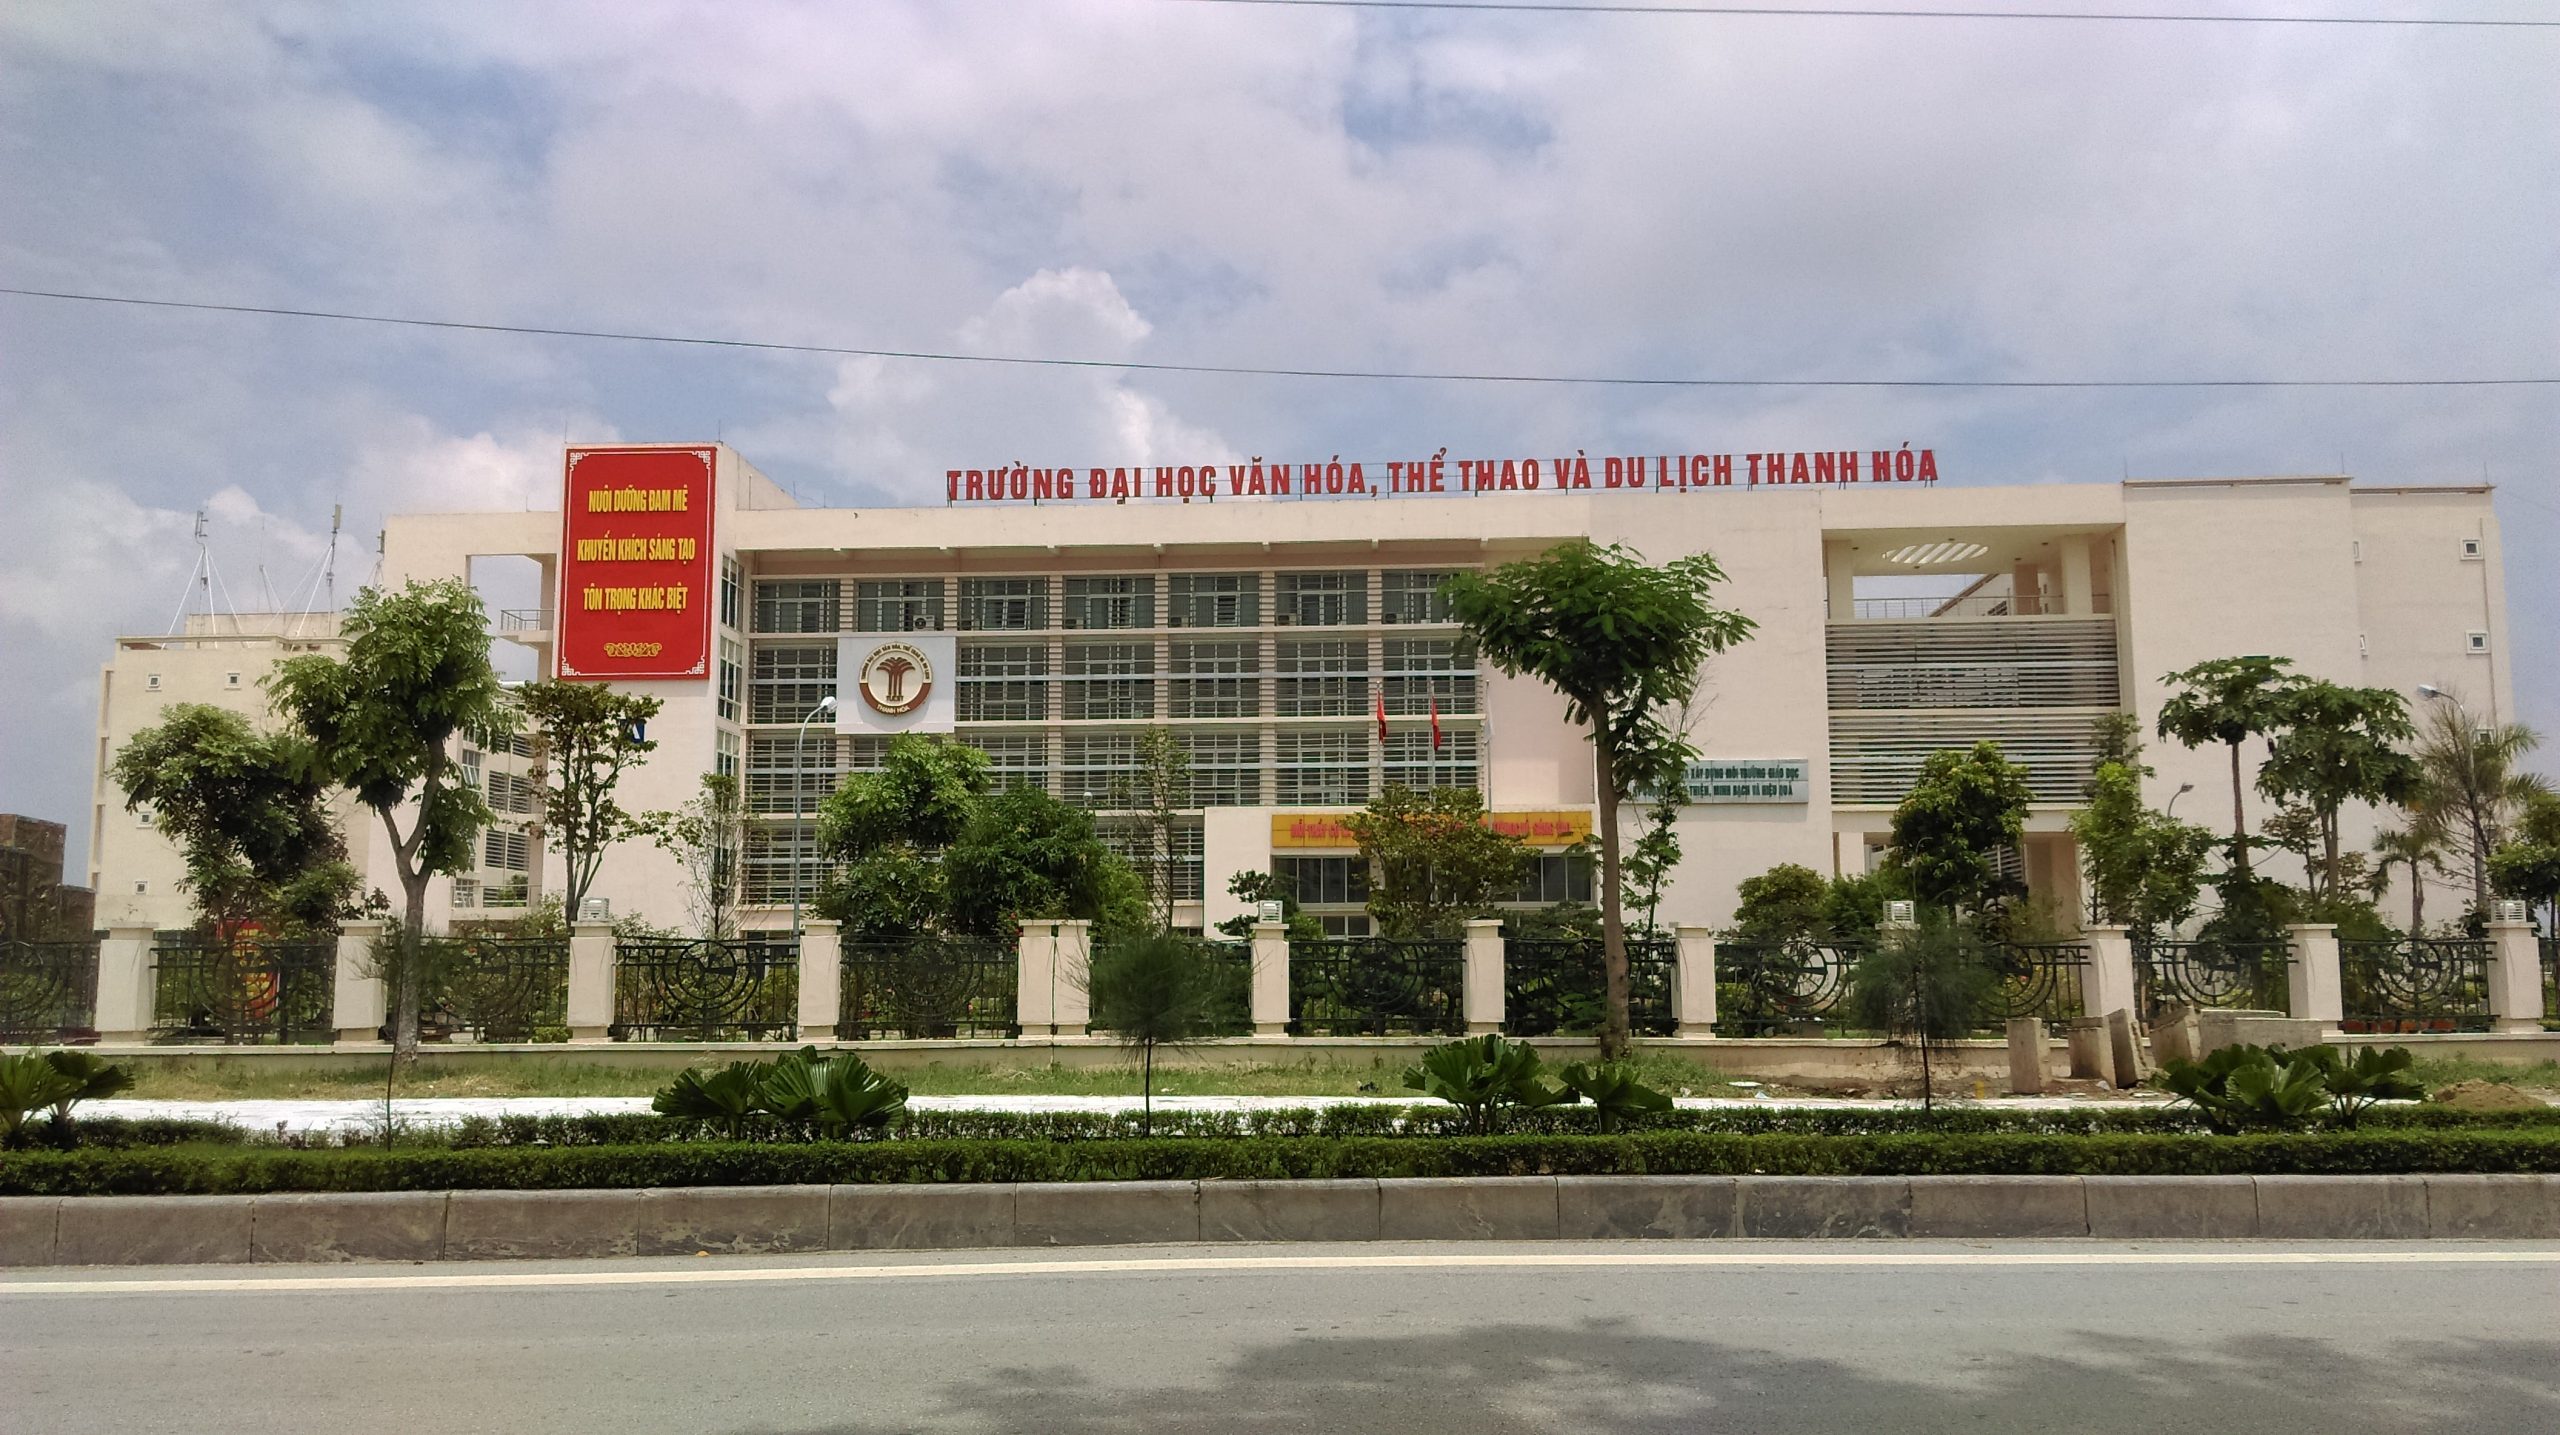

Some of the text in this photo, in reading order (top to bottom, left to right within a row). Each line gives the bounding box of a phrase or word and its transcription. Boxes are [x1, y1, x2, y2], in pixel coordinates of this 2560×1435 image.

[947, 441, 1938, 504] TRƯỜNG ĐẠI HỌC VĂN HÓA, THỂ THAO VÀ DU LỊCH THANH HÓA
[588, 484, 688, 512] NUÔI DƯỠNG ĐAM MÊ
[577, 530, 696, 565] KHUYẾN KHÍCH SÁNG TẠO
[584, 582, 688, 615] TÔN TRỌNG KHÁC BIỆT
